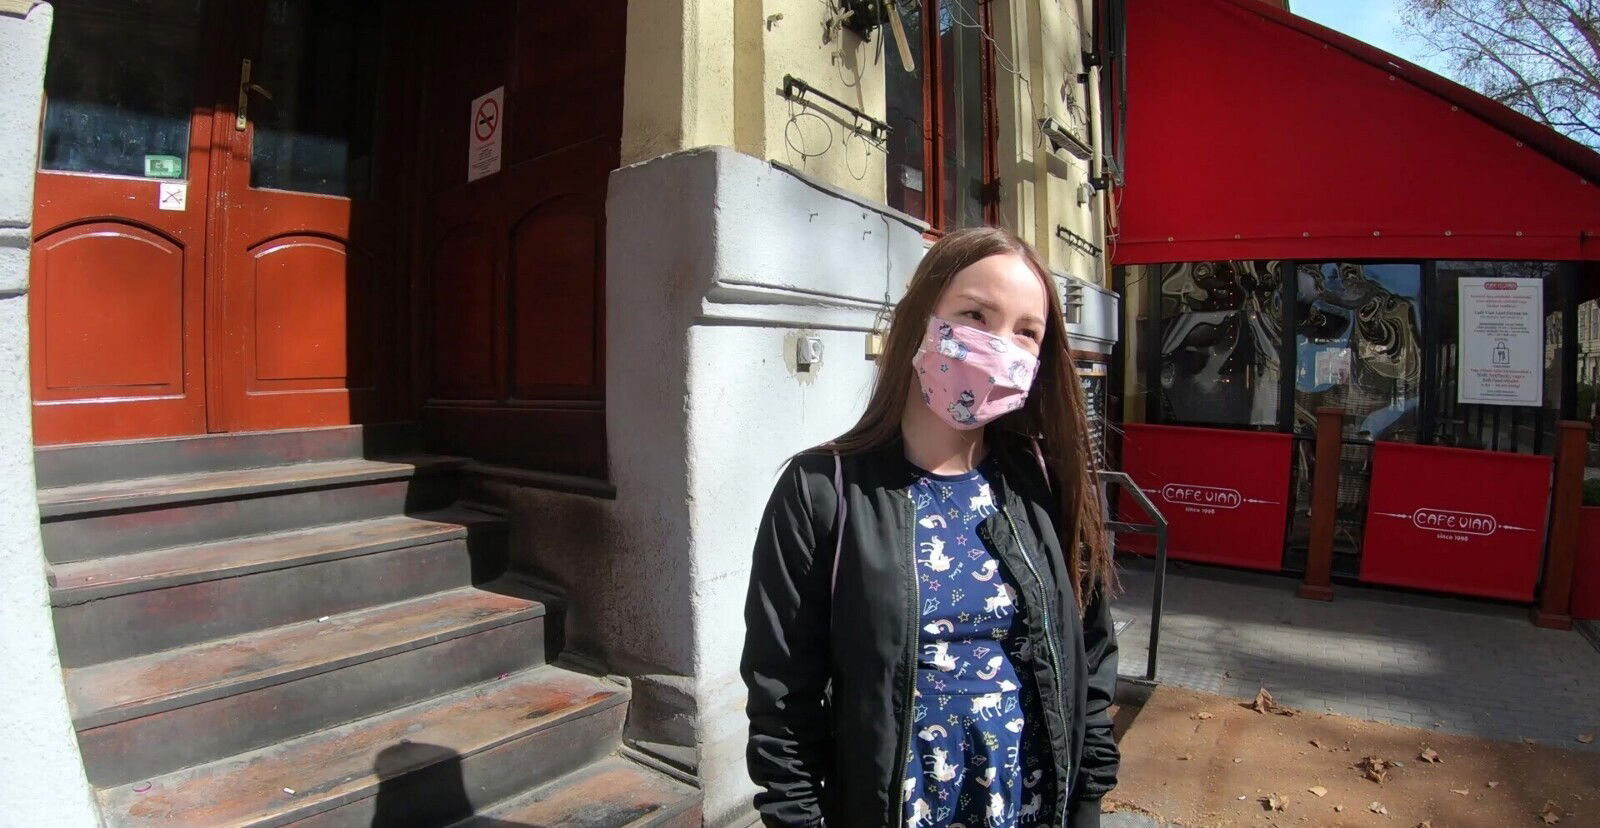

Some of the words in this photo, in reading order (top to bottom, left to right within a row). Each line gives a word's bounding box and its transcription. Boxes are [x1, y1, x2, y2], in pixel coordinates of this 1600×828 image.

[1165, 487, 1202, 502] CAFE
[1205, 490, 1238, 505] VIAN
[1417, 512, 1456, 528] CAFE
[1459, 516, 1493, 531] VIAN
